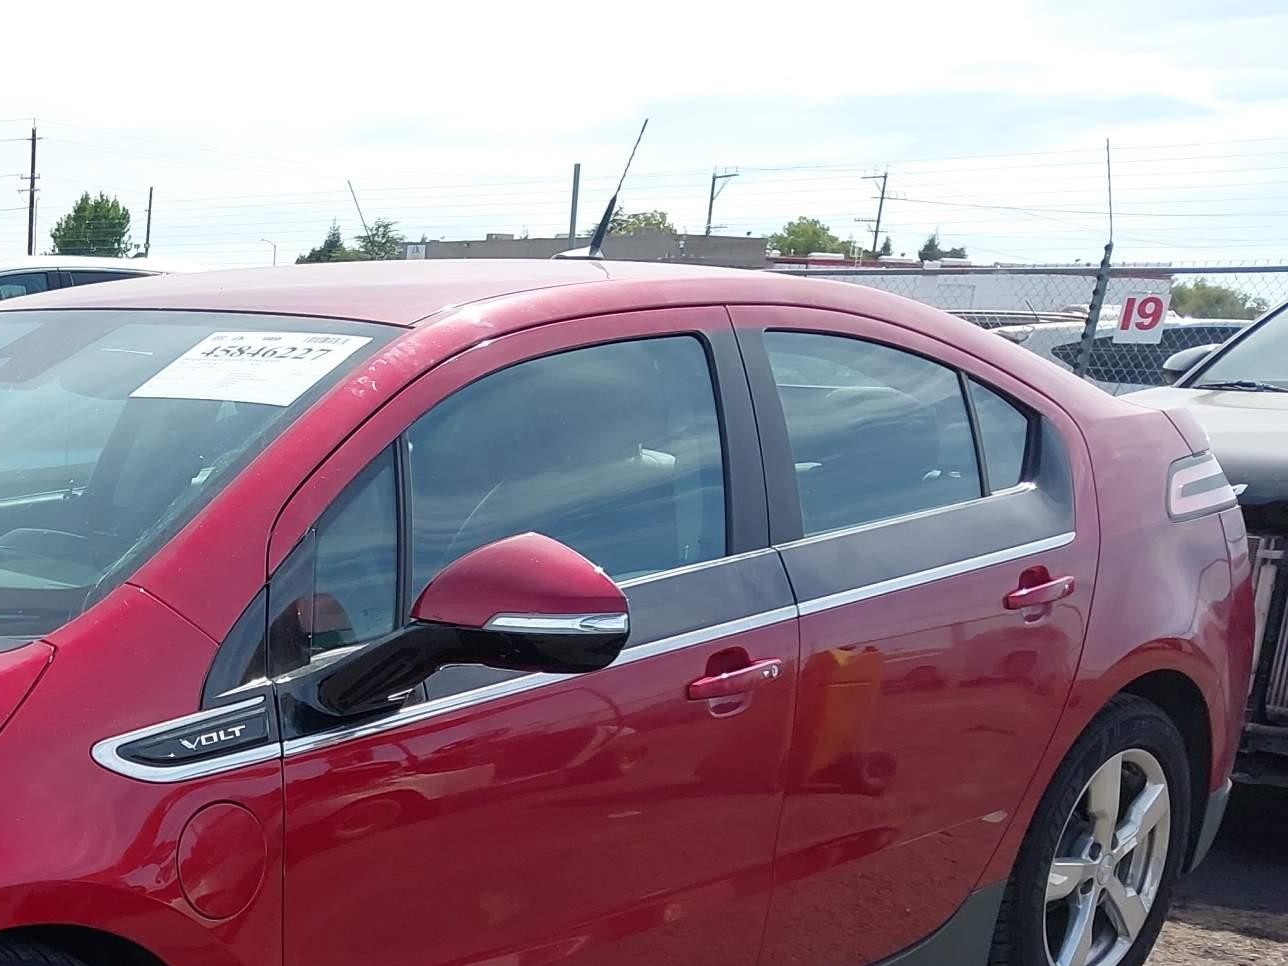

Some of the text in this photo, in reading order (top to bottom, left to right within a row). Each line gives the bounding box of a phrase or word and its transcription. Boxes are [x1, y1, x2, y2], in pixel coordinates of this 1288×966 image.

[1119, 296, 1164, 331] 19
[200, 345, 334, 360] 45846227
[179, 724, 246, 751] VOLT
